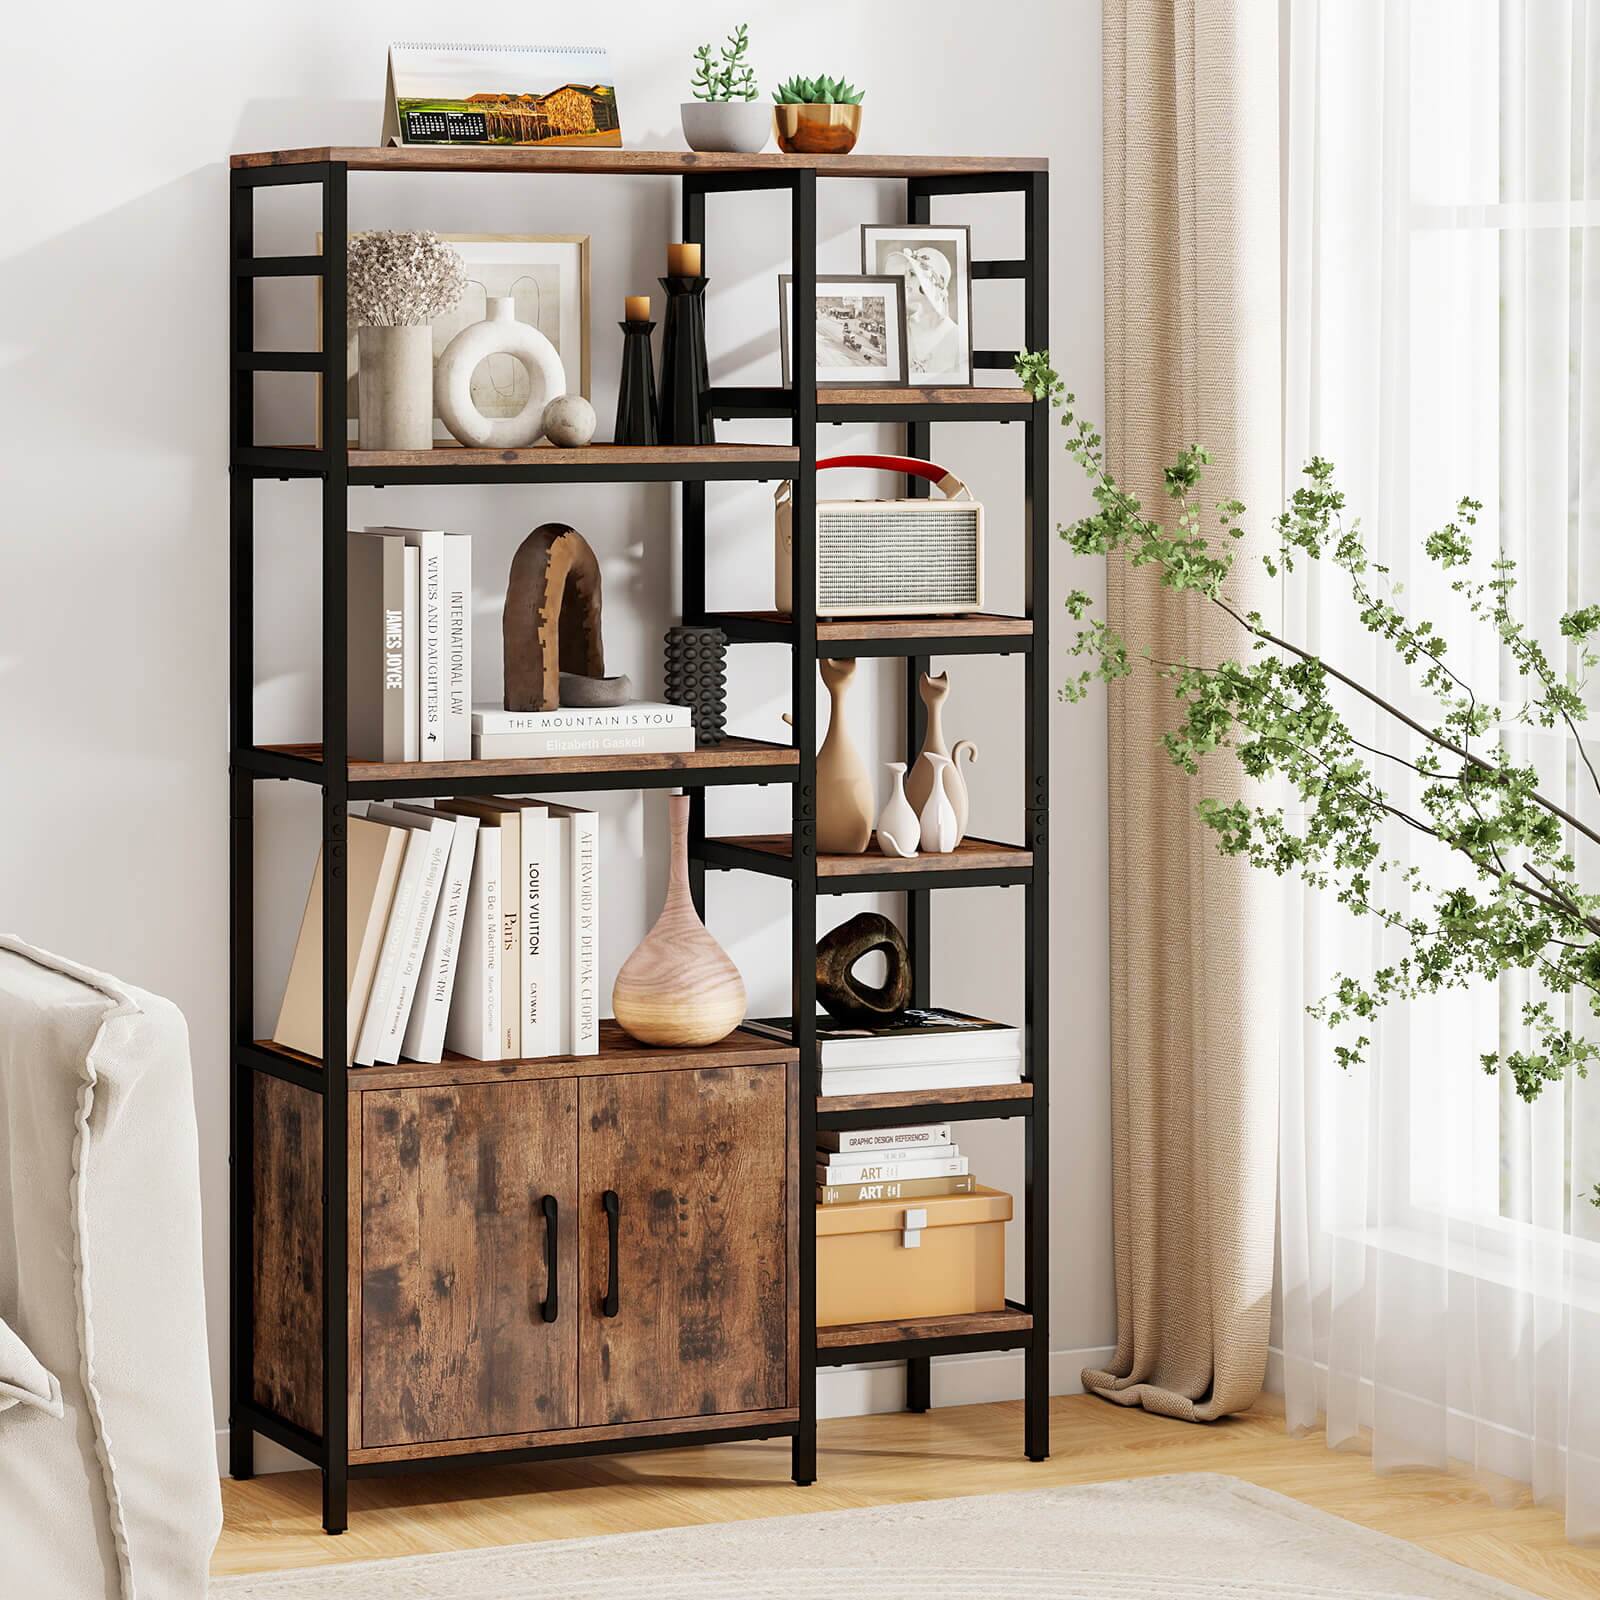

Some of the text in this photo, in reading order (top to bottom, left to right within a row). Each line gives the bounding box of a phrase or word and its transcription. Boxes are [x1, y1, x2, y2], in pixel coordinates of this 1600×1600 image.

[386, 609, 403, 690] JAMES JOYCE
[428, 556, 438, 723] WIVES AND DAUGHTERS
[451, 591, 463, 715] INTERNATIONAL LAW
[509, 713, 674, 729] THE MOUNTAIN IS YOU
[546, 735, 645, 752] Elizabeth Gaskell
[488, 880, 496, 892] To
[488, 895, 496, 910] Be
[403, 847, 442, 976] for a sustainable lifestyle
[529, 863, 540, 956] LOUIS VUITTON
[581, 916, 592, 931] BY
[488, 924, 496, 969] Machine
[504, 913, 517, 951] Paris
[434, 959, 450, 1001] DREAM
[581, 988, 592, 1040] CHOPRA
[849, 1137, 873, 1146] GRAPHIC
[874, 1135, 893, 1145] DESIGN
[858, 1185, 884, 1200] ART
[860, 1167, 882, 1181] ART
